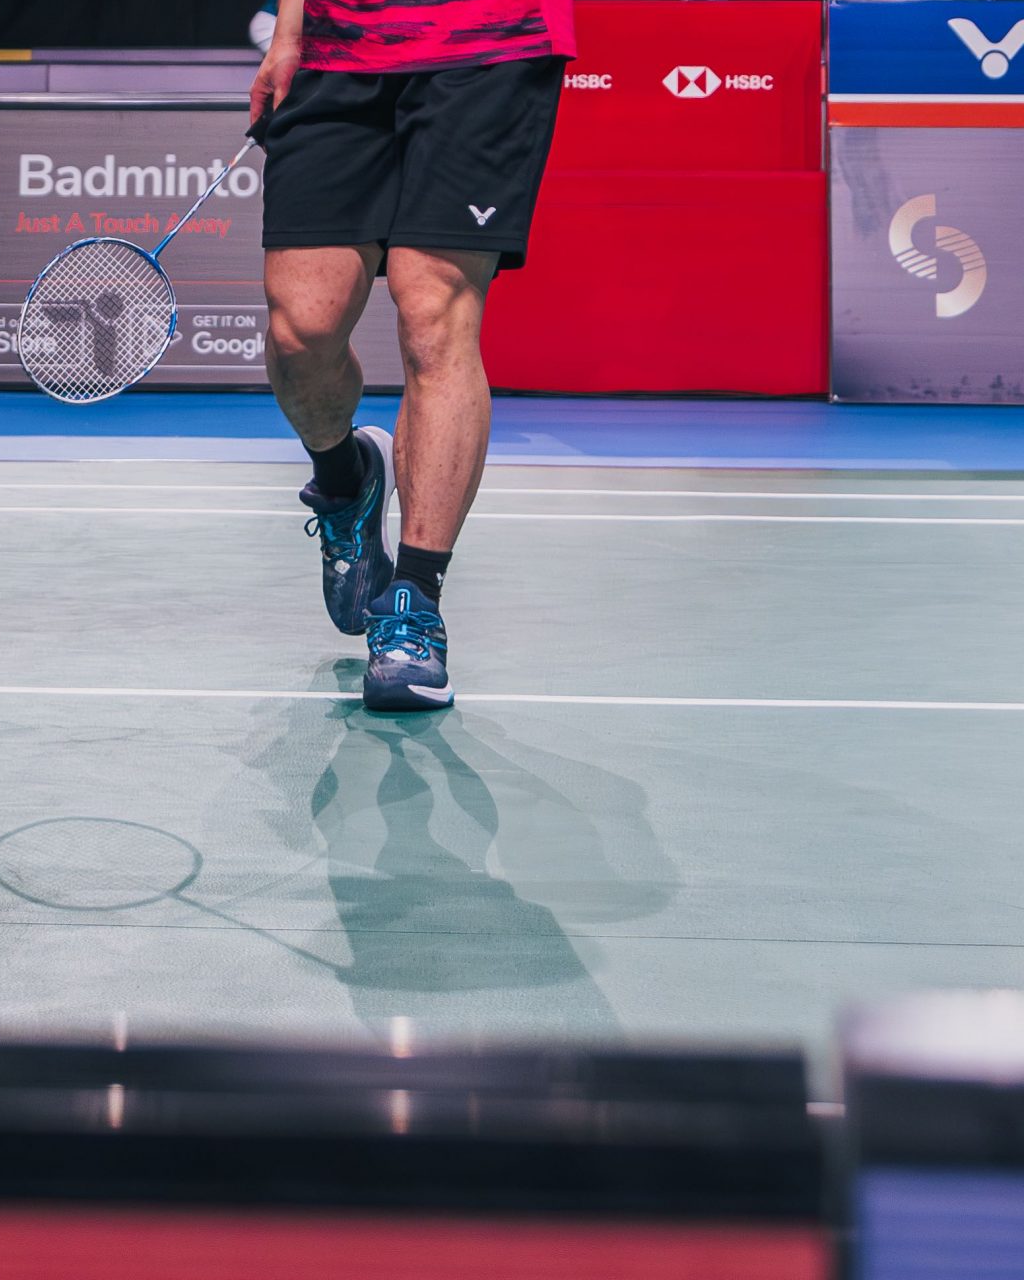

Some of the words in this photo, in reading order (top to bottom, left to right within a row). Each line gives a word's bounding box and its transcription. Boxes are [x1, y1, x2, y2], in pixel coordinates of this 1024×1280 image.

[564, 74, 613, 89] HSBC
[725, 74, 774, 90] HSBC
[19, 153, 260, 198] Badminto
[15, 211, 61, 234] Just
[65, 212, 85, 233] A
[89, 211, 159, 233] Touch
[163, 212, 233, 239] Away
[192, 315, 221, 328] GET
[221, 315, 233, 328] IT
[235, 315, 256, 328] ON
[192, 330, 266, 360] Googl
